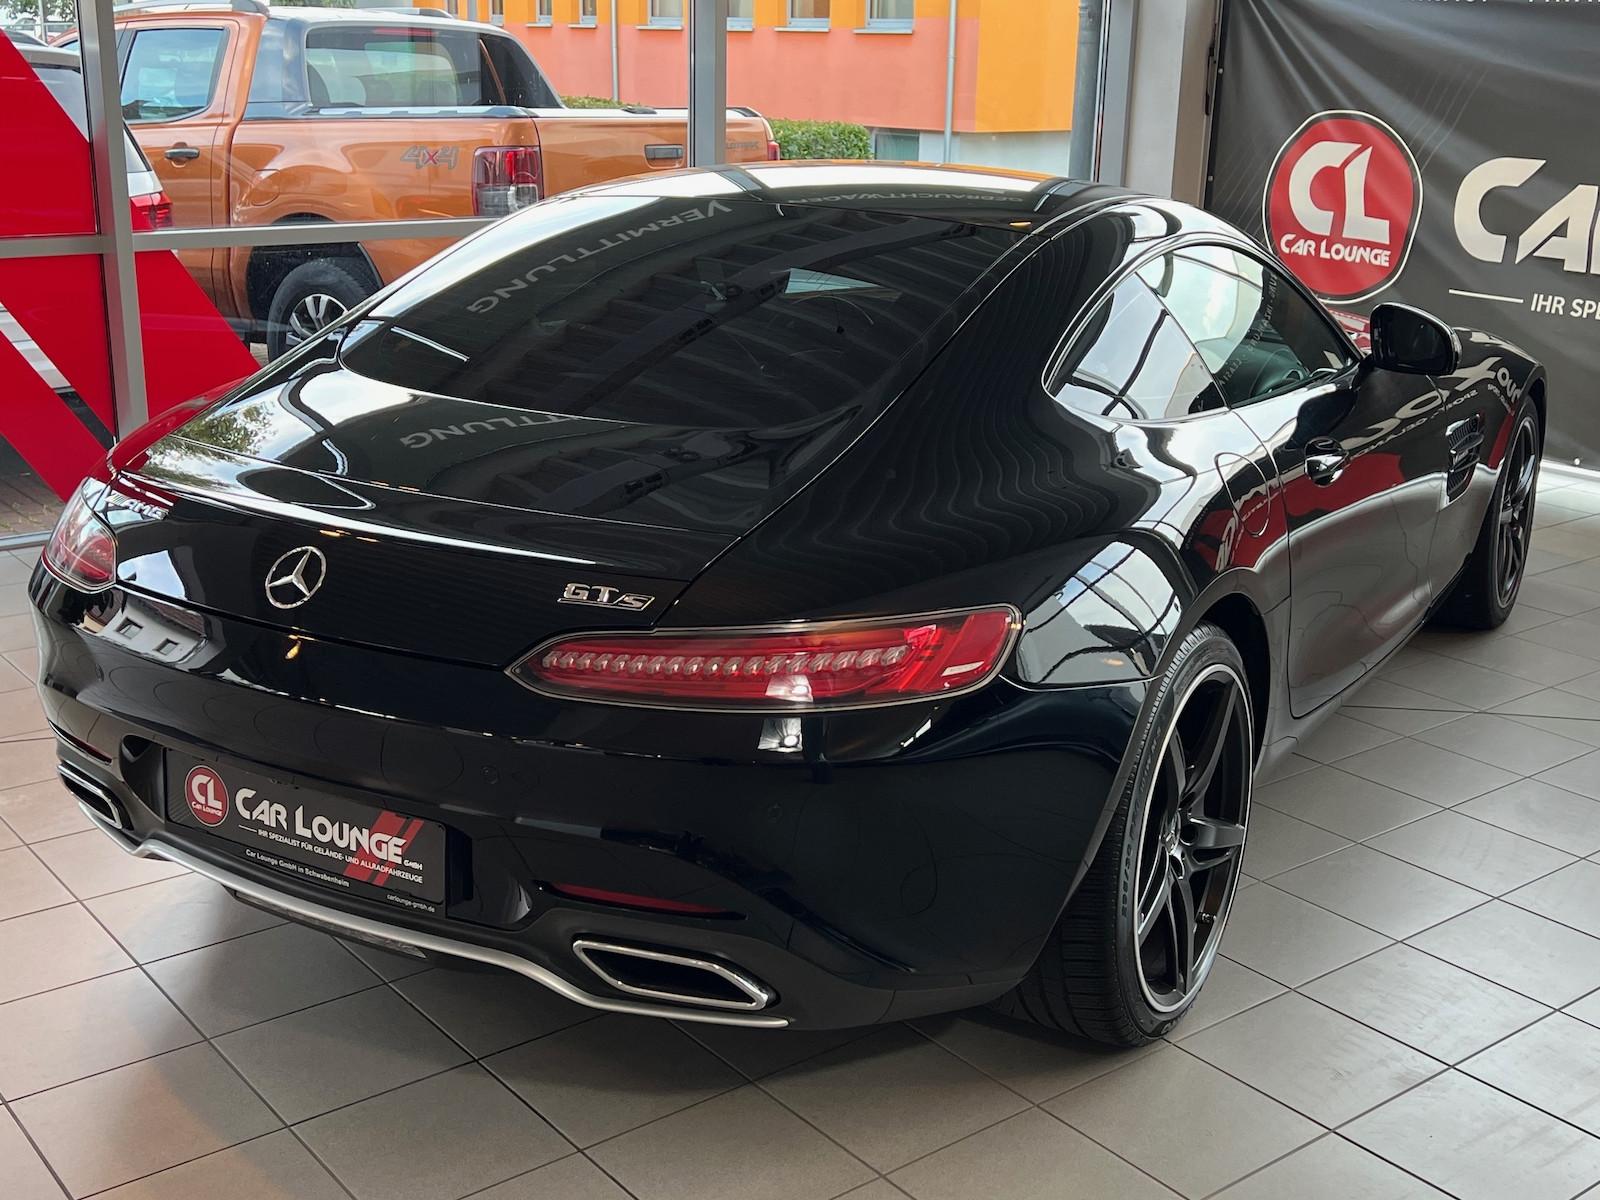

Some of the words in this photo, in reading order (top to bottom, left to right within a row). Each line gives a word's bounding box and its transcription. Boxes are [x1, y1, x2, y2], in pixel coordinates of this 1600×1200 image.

[1288, 141, 1390, 244] CL
[1453, 157, 1600, 274] CA
[466, 199, 733, 314] VERMITTLUNG
[1280, 233, 1317, 257] CAR
[1319, 239, 1391, 267] LOUNGE
[1530, 293, 1565, 316] IHR
[235, 787, 288, 831] CAR
[295, 804, 408, 865] LOUNGE
[268, 832, 301, 848] SPEZIALIST
[301, 841, 314, 852] FÜR
[344, 855, 360, 866] UND
[359, 860, 424, 884] ALLRADFAHRZEUGE
[245, 848, 257, 858] Car
[256, 852, 279, 867] Lounge
[278, 860, 298, 871] GmbH
[304, 868, 350, 888] Schwabenheim
